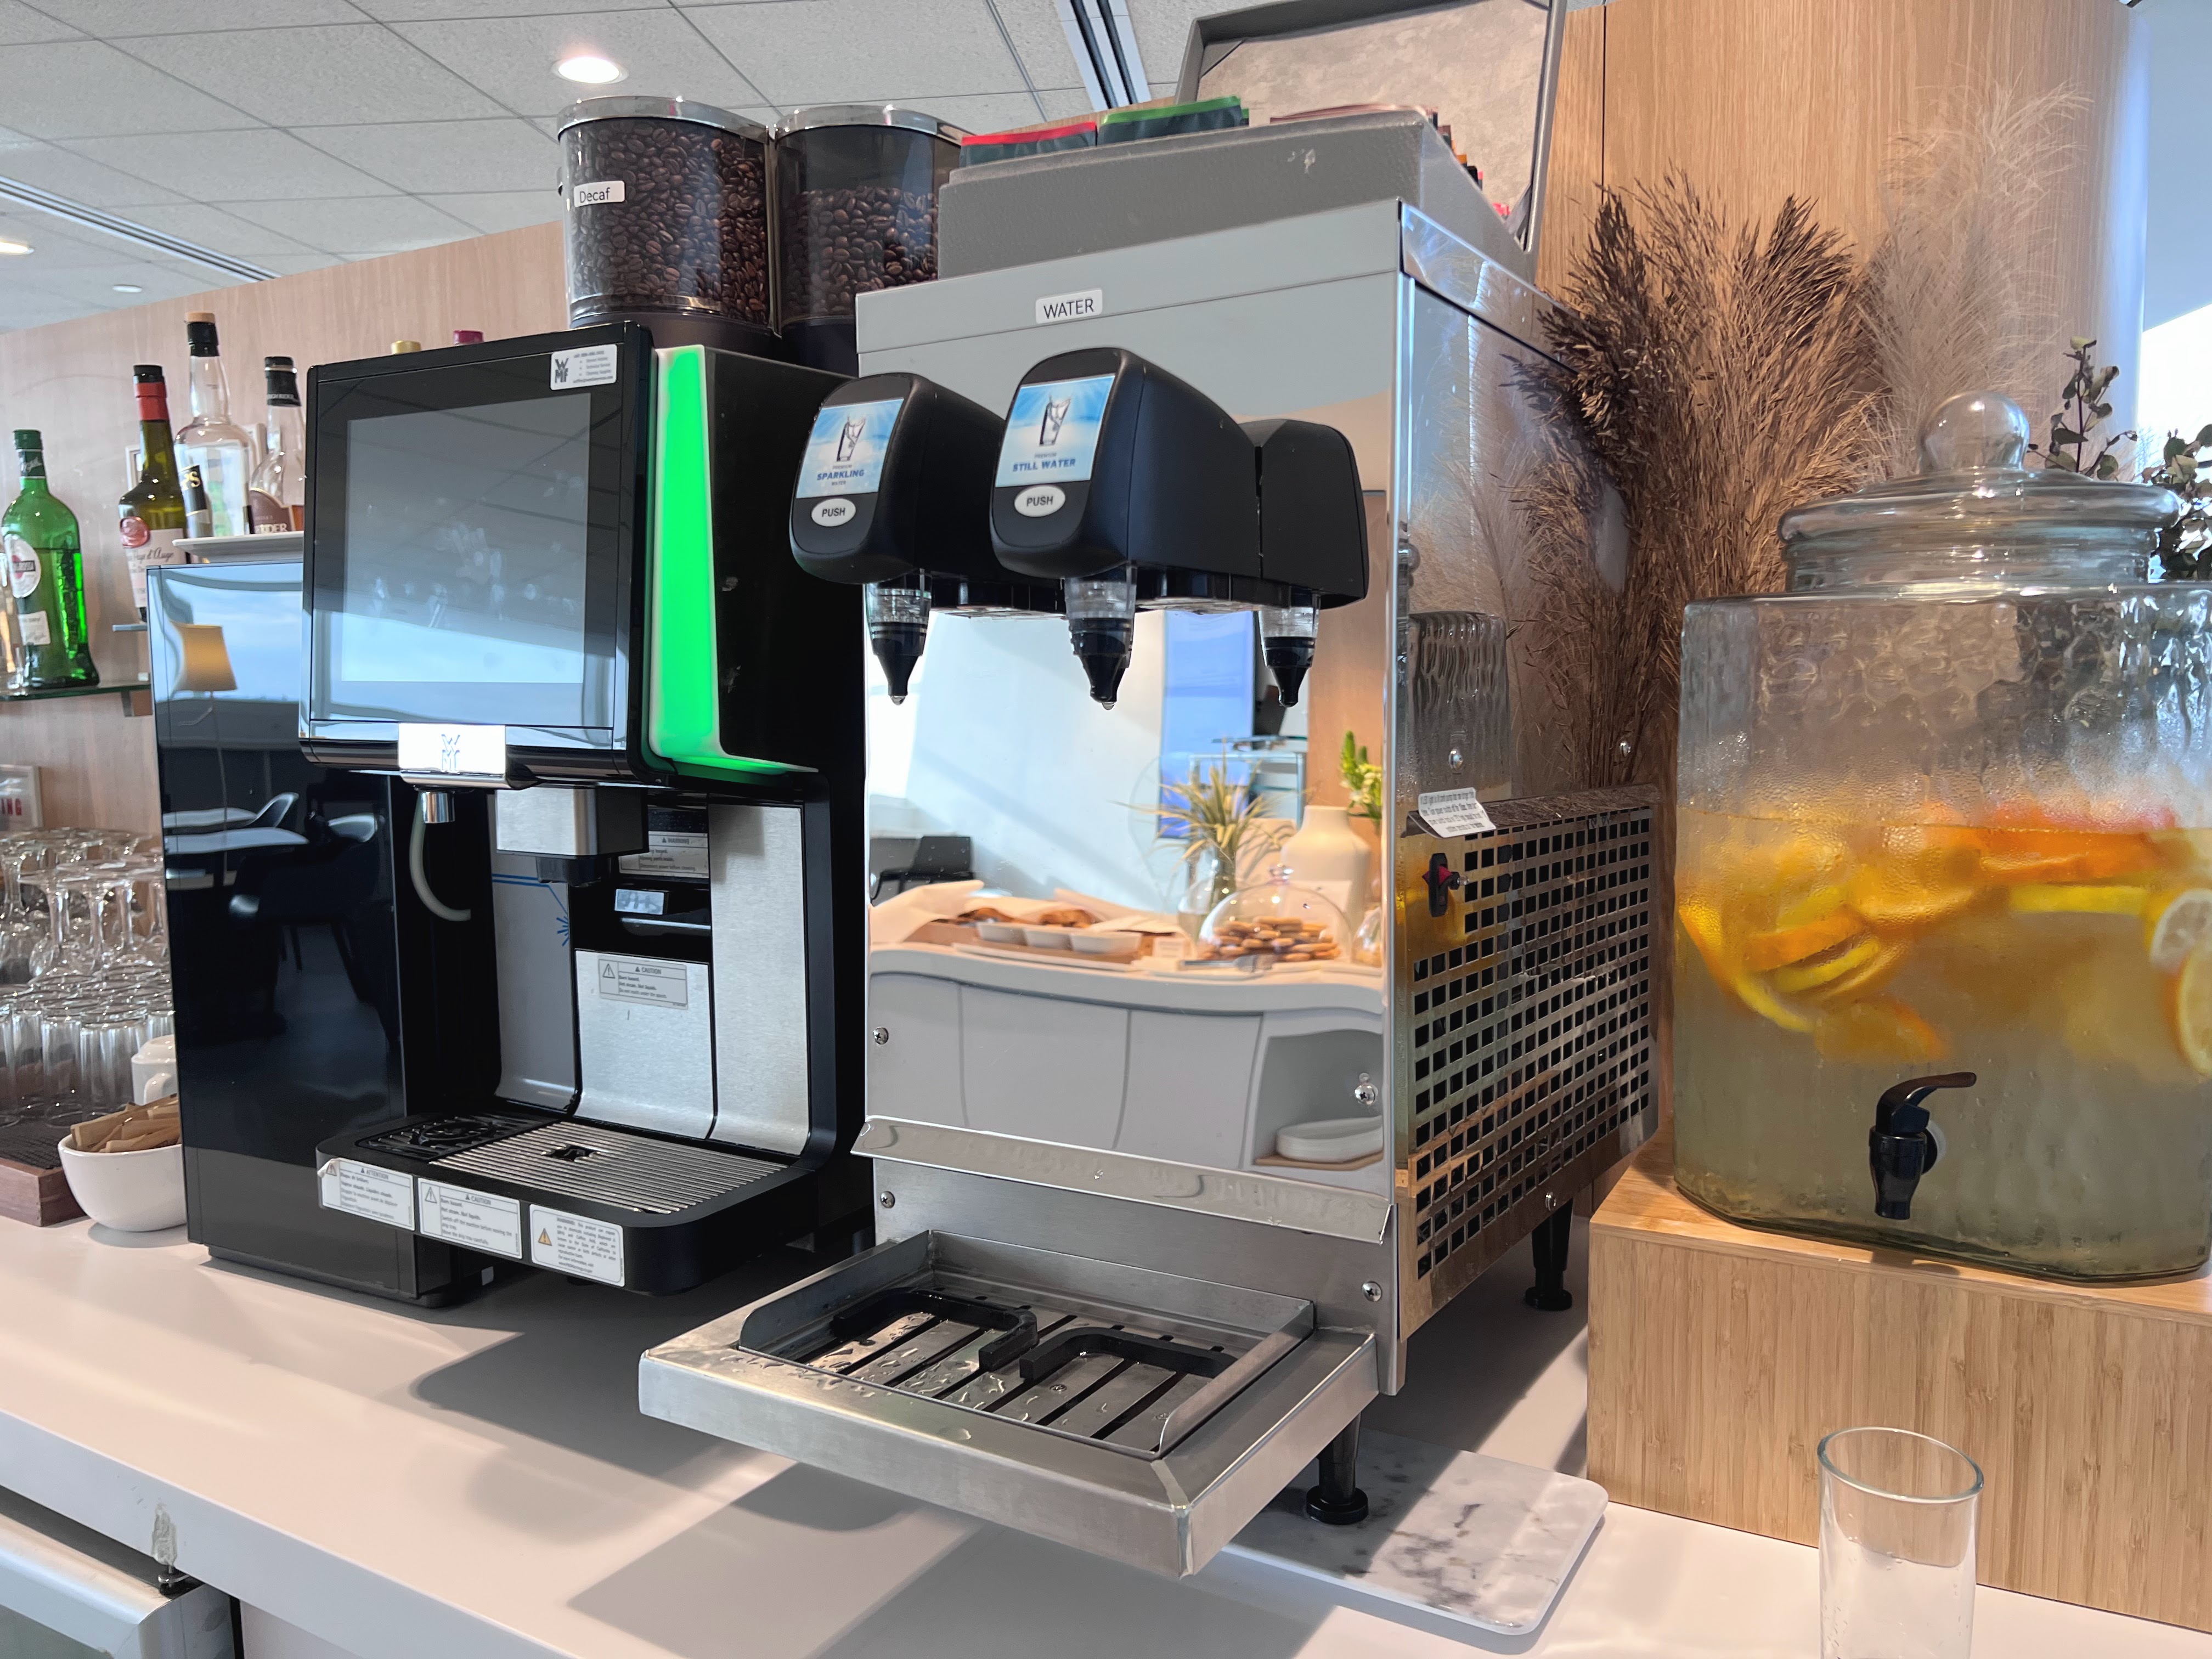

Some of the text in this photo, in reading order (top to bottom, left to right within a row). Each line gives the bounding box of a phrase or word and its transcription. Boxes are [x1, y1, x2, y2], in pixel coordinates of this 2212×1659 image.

[579, 187, 611, 203] Decaf
[1043, 298, 1094, 319] WATER
[1012, 459, 1076, 472] STILL WATER
[817, 470, 865, 481] SPARKLING
[1026, 496, 1053, 507] PUSH
[822, 508, 846, 517] PUSH
[641, 967, 662, 975] CAUTION
[366, 1169, 389, 1180] ATTENTION
[471, 1196, 492, 1205] CAUTION
